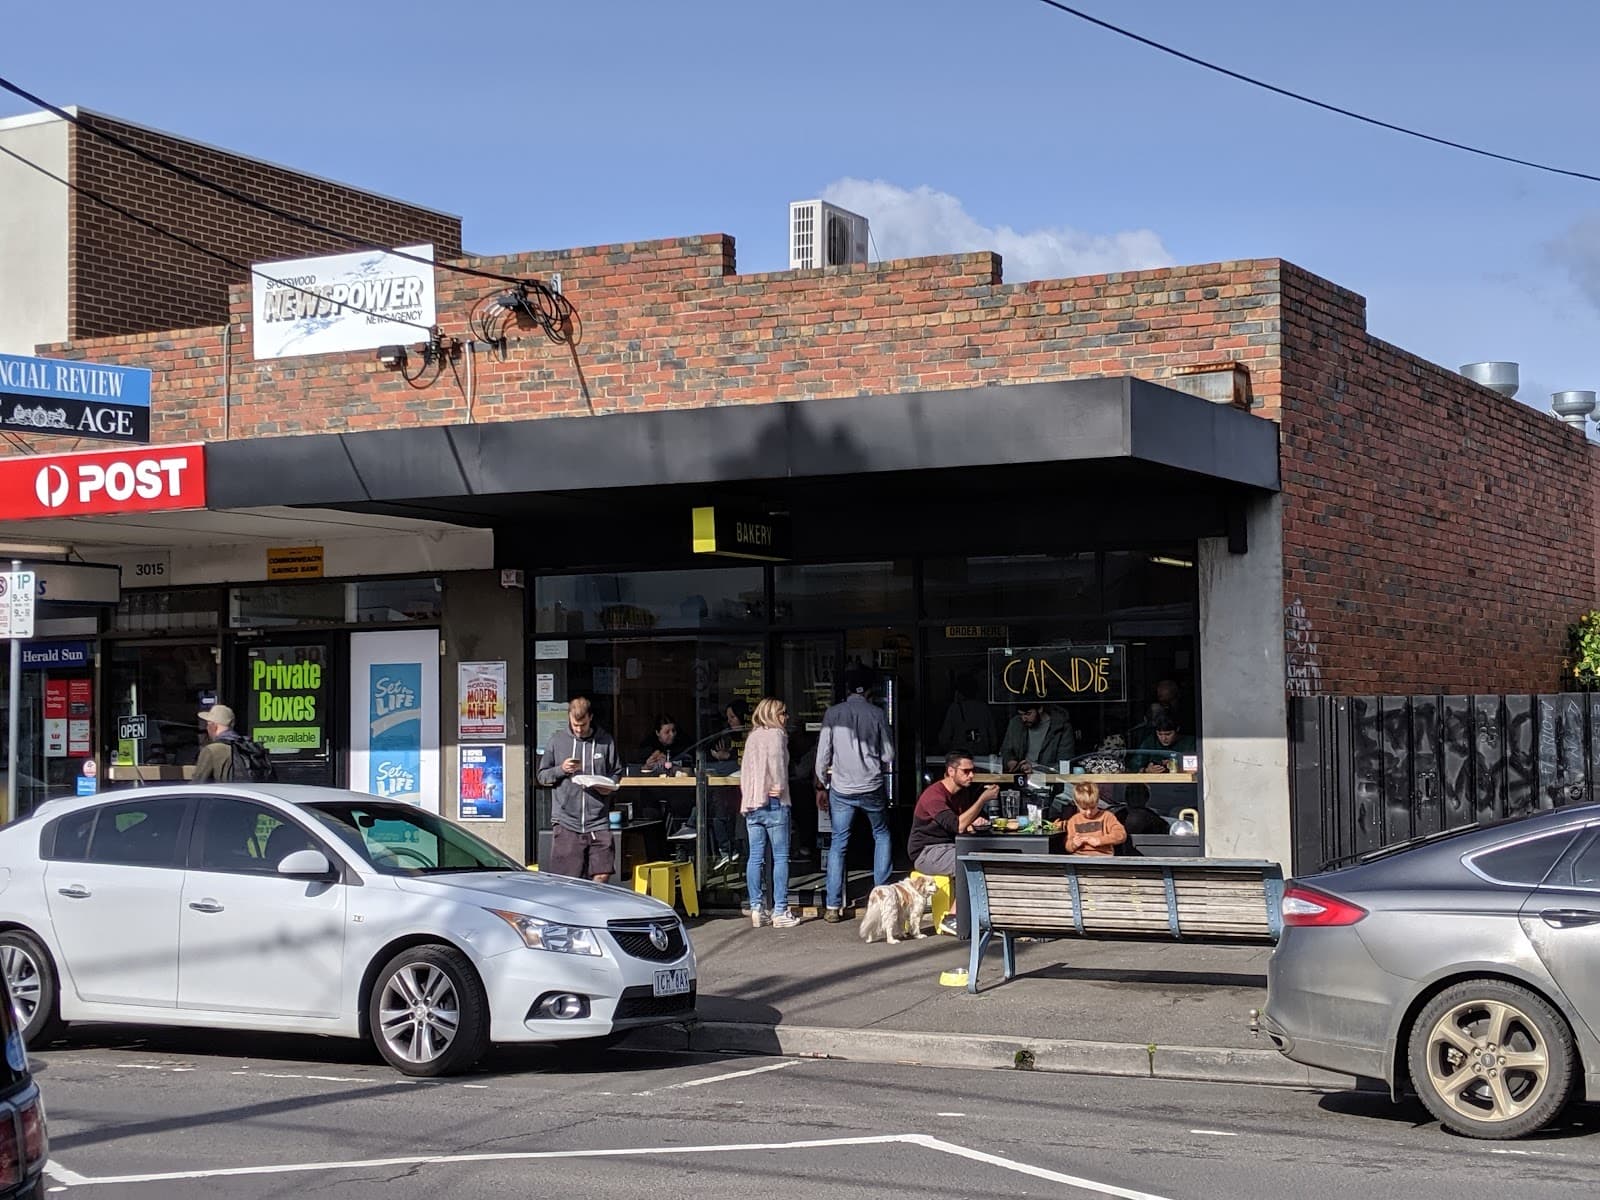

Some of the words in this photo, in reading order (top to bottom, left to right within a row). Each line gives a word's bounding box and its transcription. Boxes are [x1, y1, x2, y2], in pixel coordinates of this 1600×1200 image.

[266, 275, 316, 290] SPOTSWOOD
[262, 275, 425, 323] NEWSPOWER
[366, 310, 423, 325] NEWSAGENCY
[55, 366, 125, 398] REVIEW
[77, 406, 134, 436] AGE
[78, 457, 188, 503] POST
[736, 521, 772, 545] BAKERY
[135, 563, 165, 576] 3015
[17, 574, 31, 590] 1P
[23, 650, 59, 663] Herald
[61, 649, 83, 661] Sun
[253, 659, 321, 690] Private
[374, 677, 401, 698] Set
[467, 689, 498, 703] MODERN
[259, 691, 316, 722] Boxes
[375, 694, 415, 716] LIFE
[120, 723, 145, 738] OPEN
[257, 735, 275, 745] now
[277, 731, 316, 744] available
[376, 761, 403, 780] Set
[376, 777, 414, 797] LIFE
[1018, 776, 1024, 786] 6
